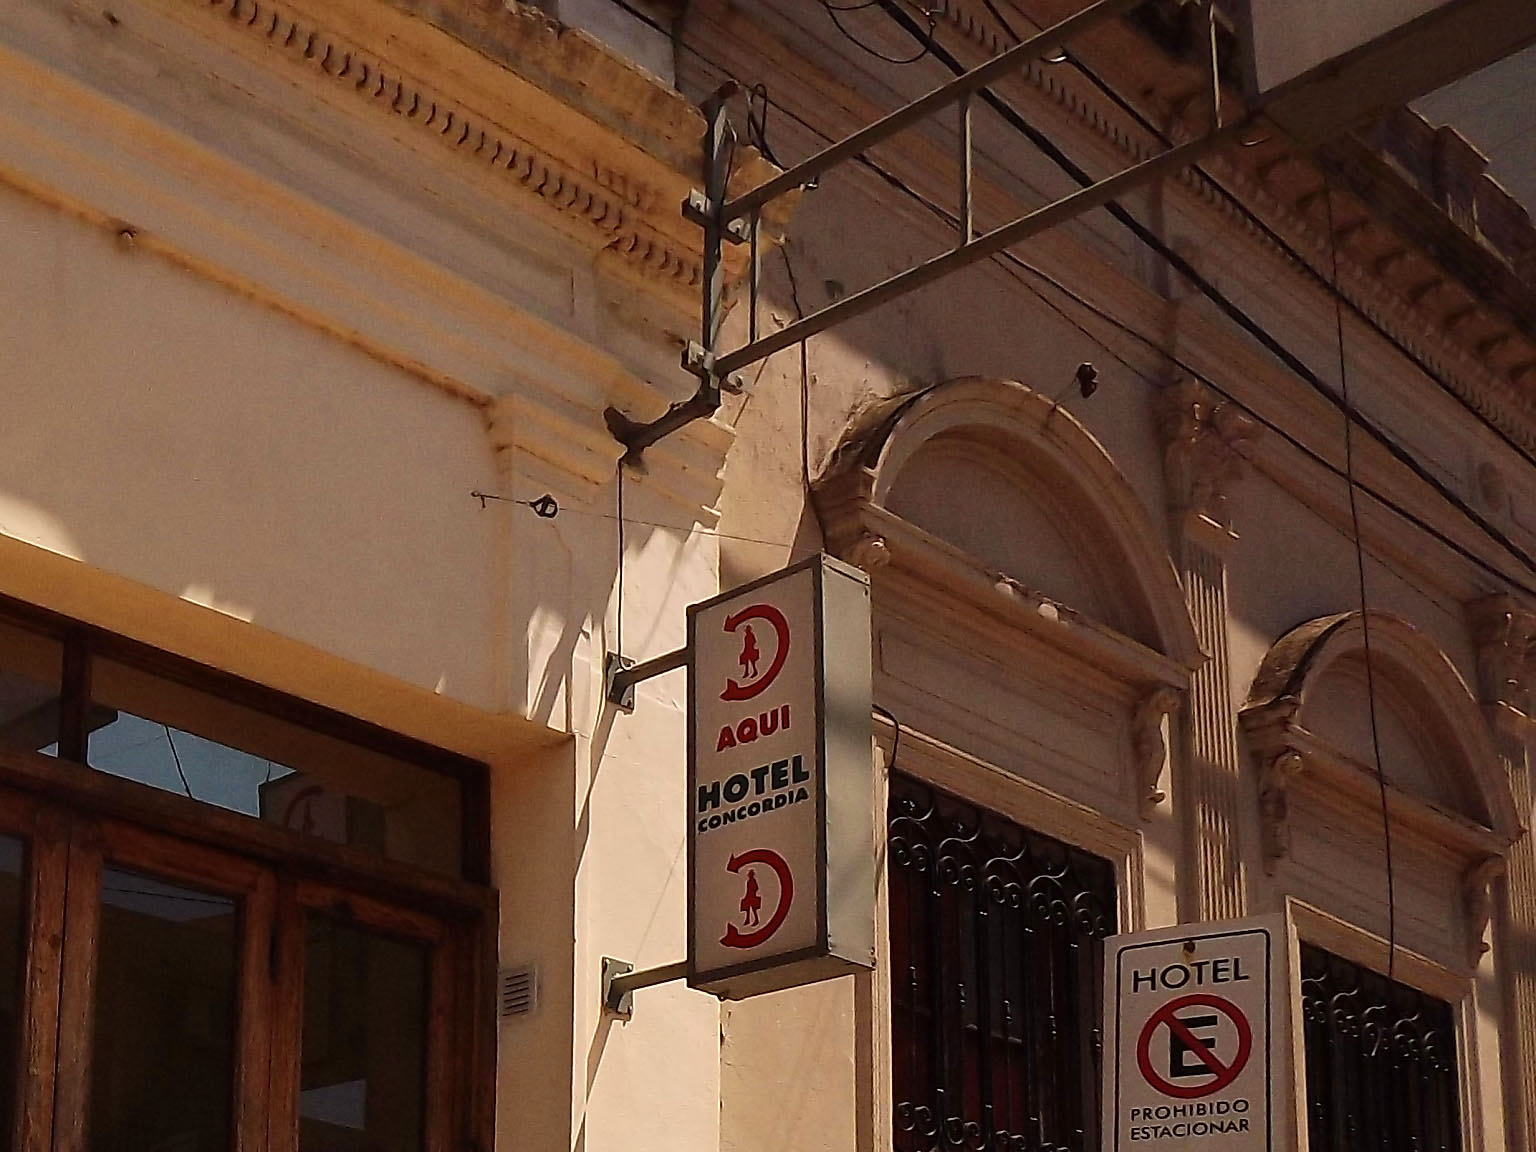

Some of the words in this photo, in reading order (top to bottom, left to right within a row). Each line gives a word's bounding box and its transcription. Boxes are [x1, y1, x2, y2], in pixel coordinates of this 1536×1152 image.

[716, 704, 791, 752] AQUI
[698, 754, 810, 814] HOTEL
[698, 786, 809, 835] CONCORDIA
[1132, 958, 1250, 993] HOTEL
[1170, 1015, 1218, 1078] E
[1130, 1119, 1250, 1141] ESTACIONAR
[1131, 1099, 1250, 1122] PROHIBIDO
